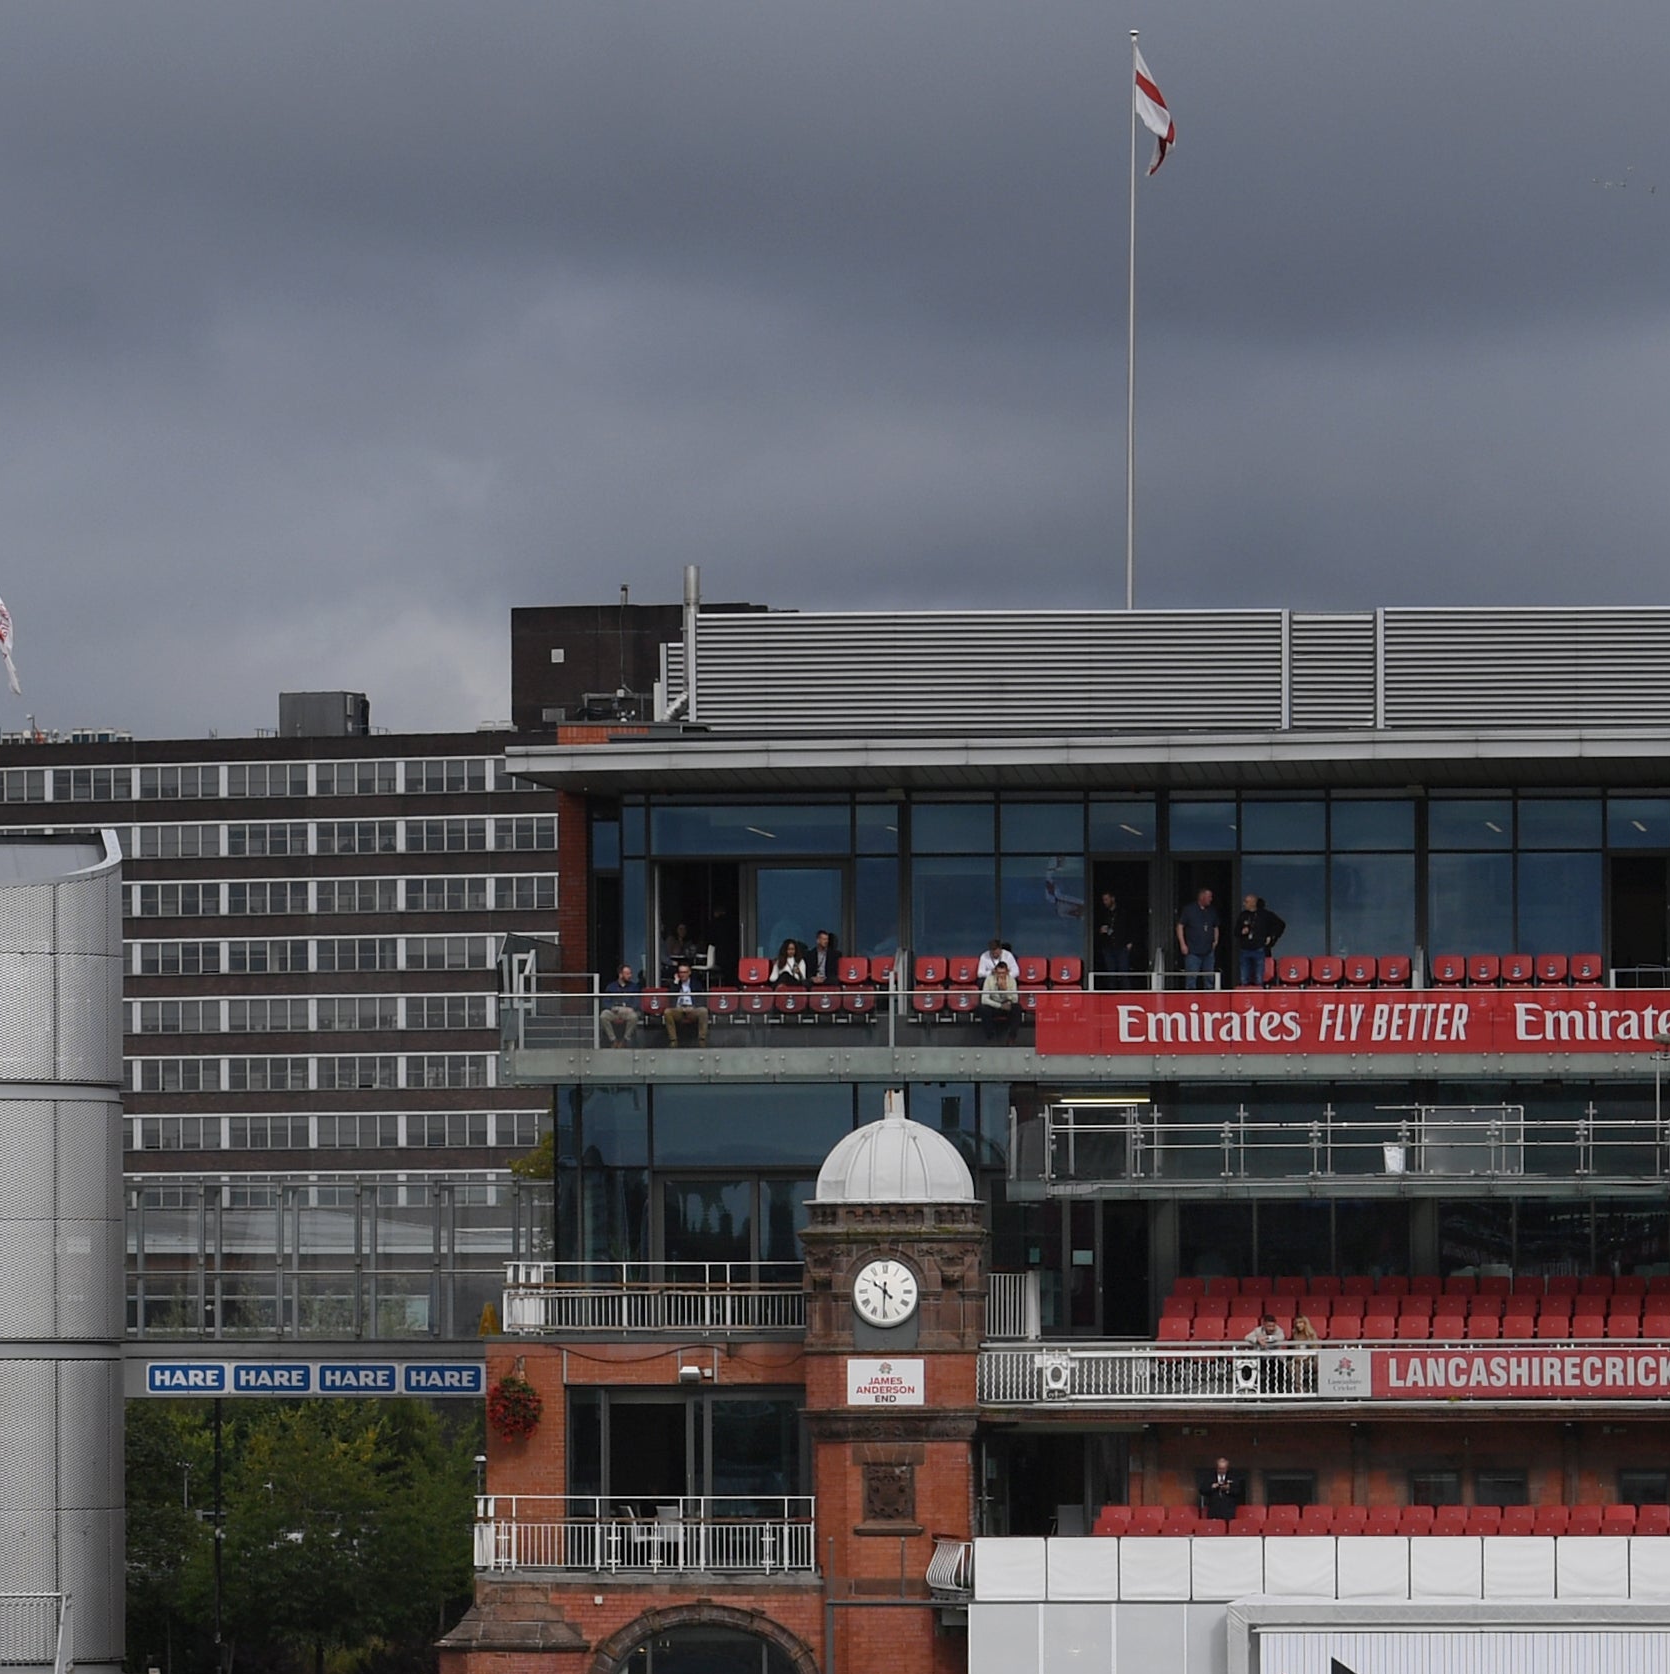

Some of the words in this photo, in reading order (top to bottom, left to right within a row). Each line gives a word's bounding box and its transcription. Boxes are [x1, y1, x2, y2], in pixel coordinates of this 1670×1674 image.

[1116, 1003, 1302, 1043] Emirates
[1318, 1003, 1365, 1041] FLY
[1370, 1003, 1469, 1041] BETTER
[154, 1370, 220, 1387] HARE
[239, 1370, 305, 1387] HARE
[324, 1370, 390, 1387] HARE
[409, 1370, 475, 1388] HARE
[868, 1377, 903, 1386] JAMES
[856, 1386, 915, 1394] ANDERSON
[874, 1395, 897, 1403] END
